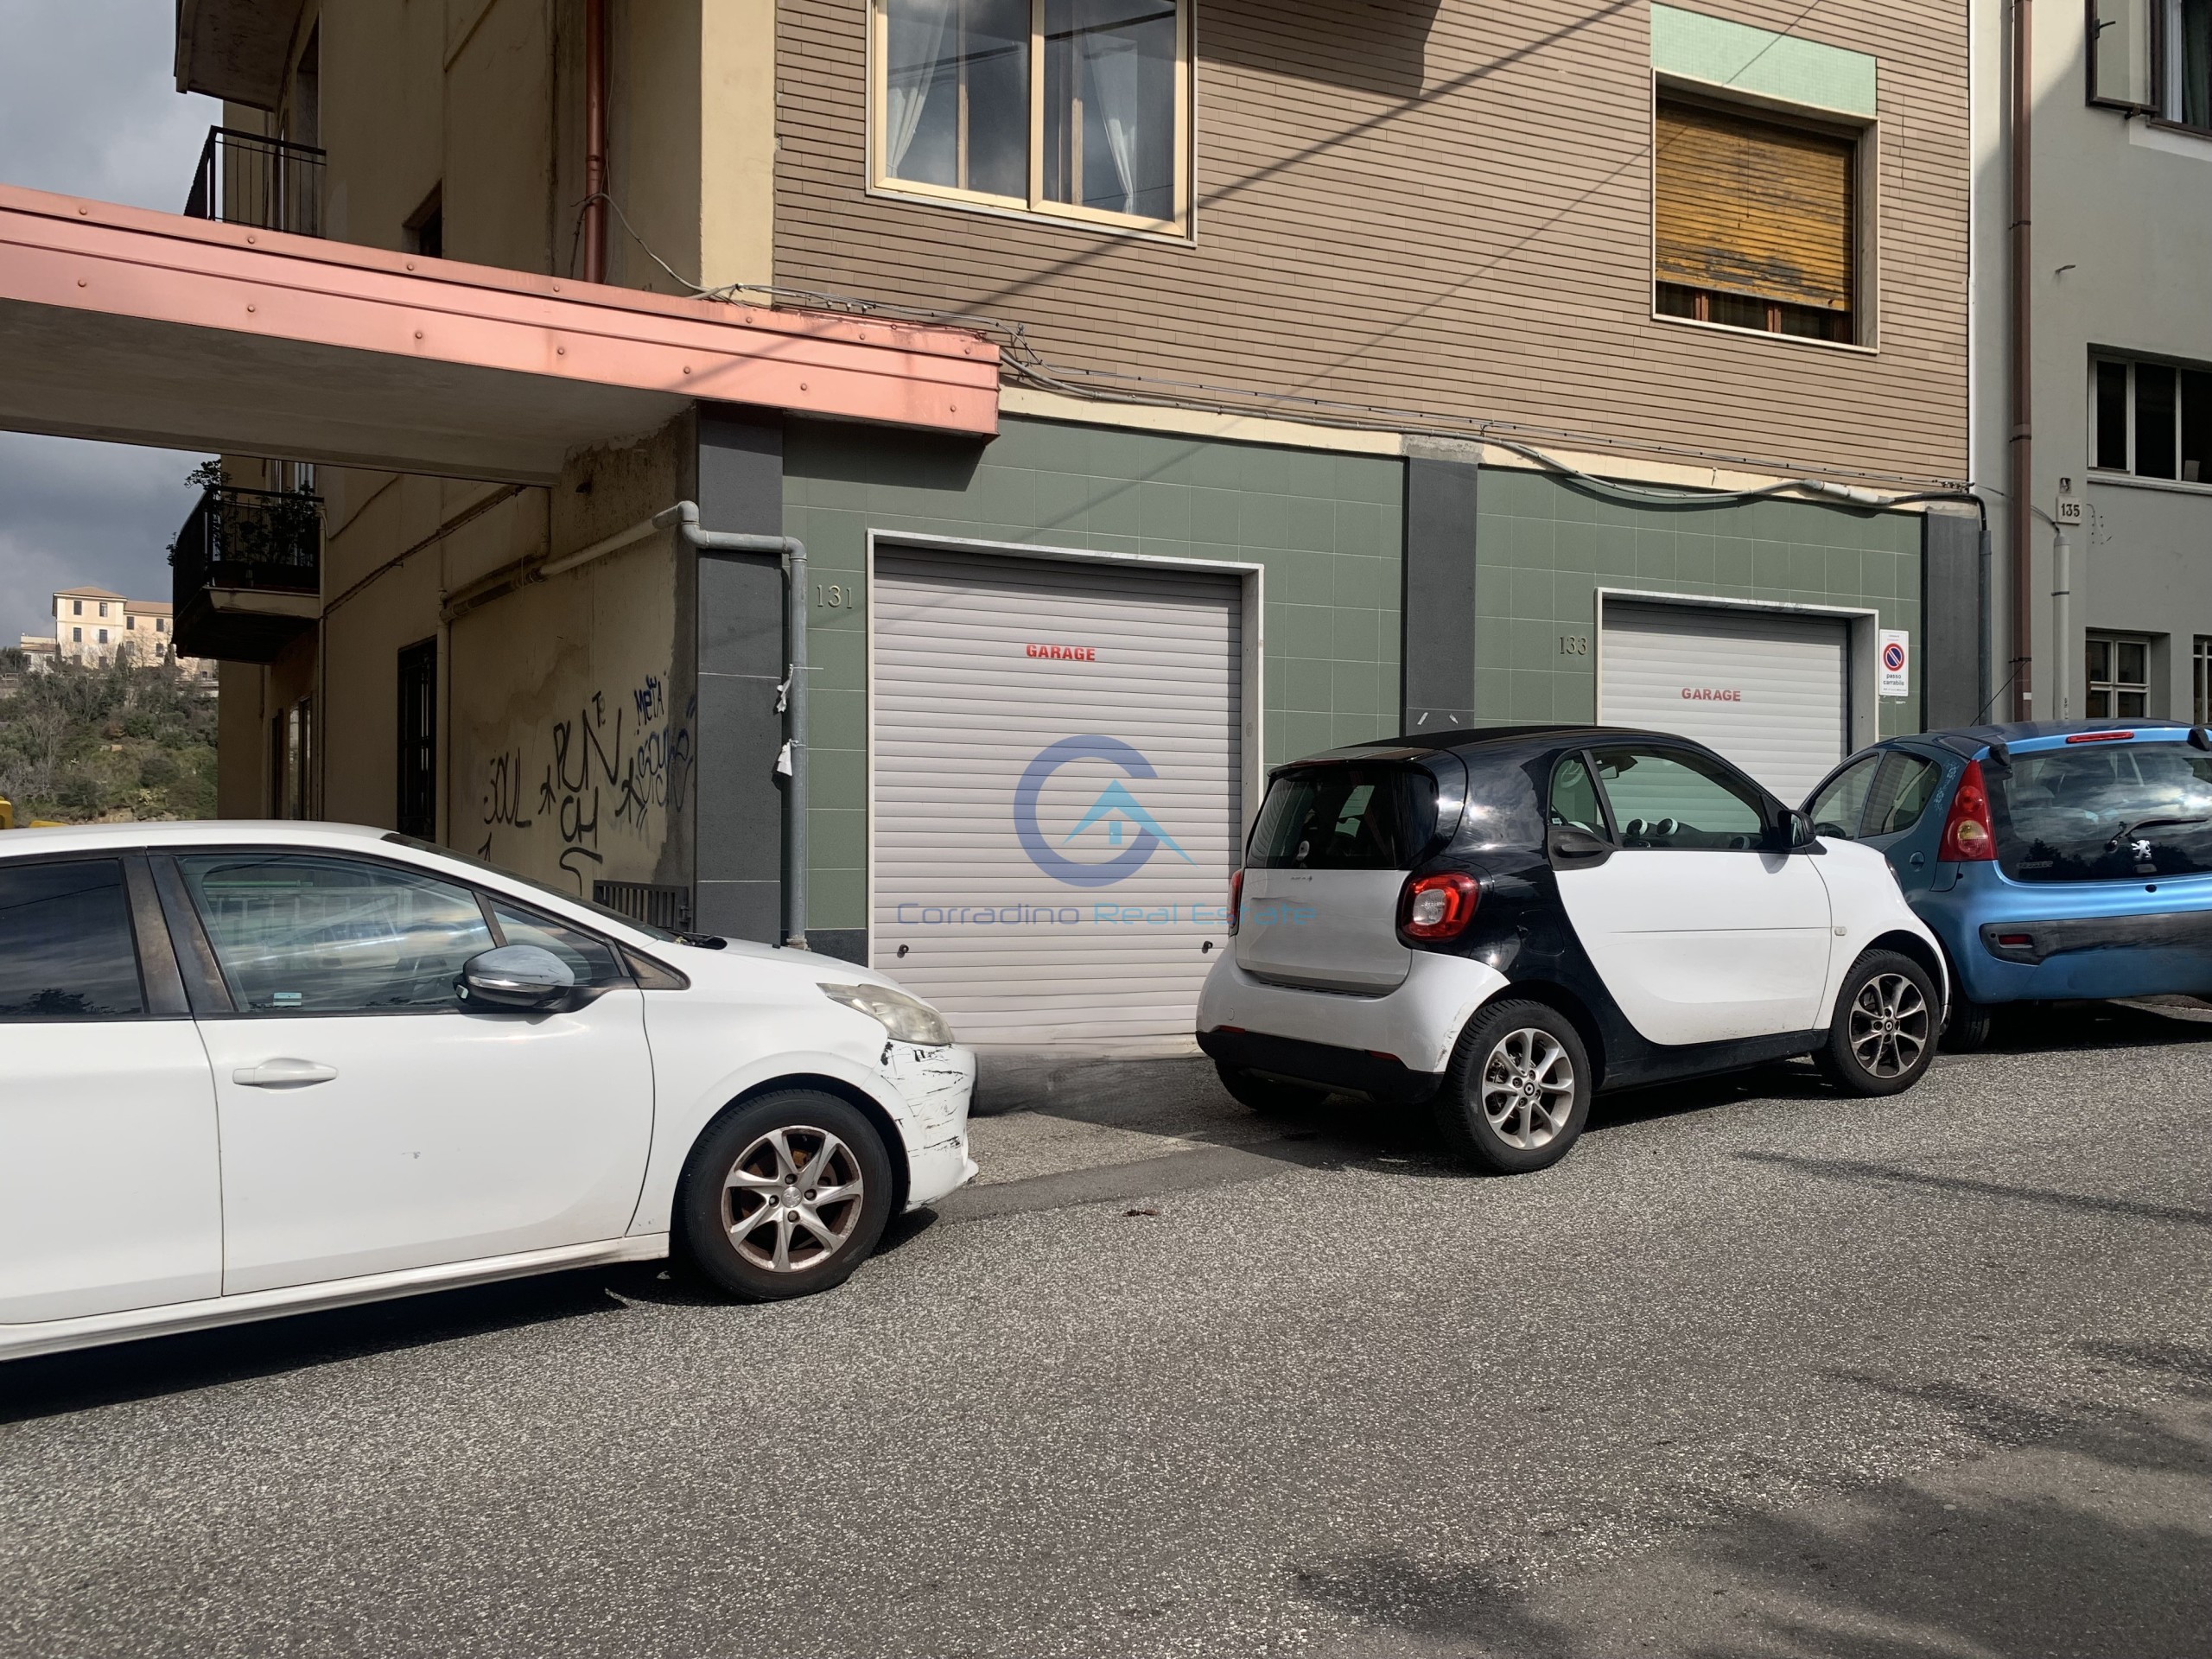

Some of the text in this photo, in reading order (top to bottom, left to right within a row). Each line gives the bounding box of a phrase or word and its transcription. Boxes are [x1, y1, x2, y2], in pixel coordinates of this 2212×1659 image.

[2061, 503, 2080, 517] 135
[817, 584, 853, 609] 131
[1026, 644, 1096, 661] GARAGE
[1560, 636, 1586, 656] 133
[1681, 688, 1741, 702] GARAGE
